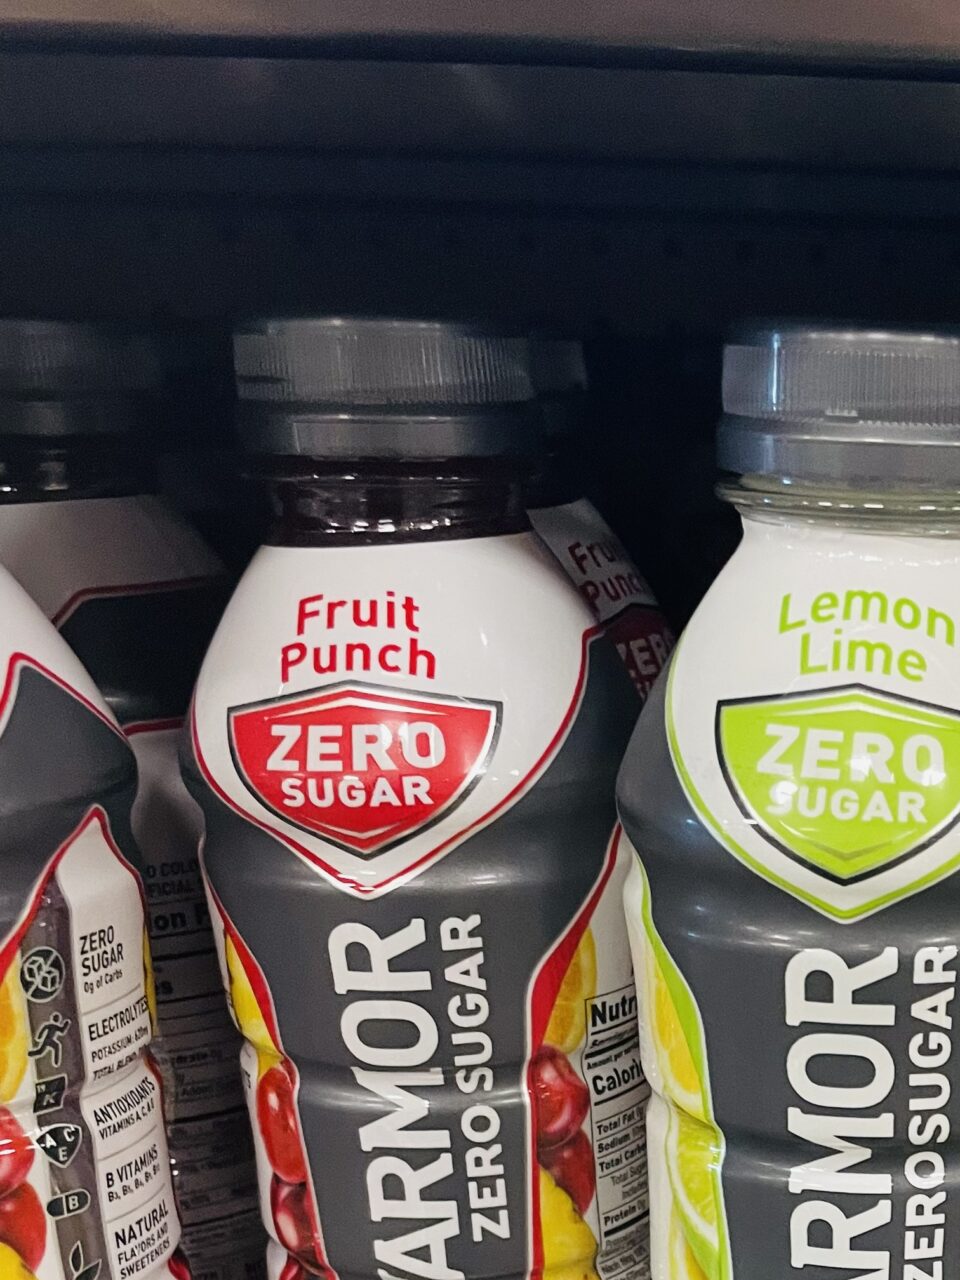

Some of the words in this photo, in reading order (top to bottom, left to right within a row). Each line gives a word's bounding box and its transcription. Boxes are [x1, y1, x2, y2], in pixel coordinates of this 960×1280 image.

[297, 590, 420, 636] Fruit
[778, 589, 956, 648] Lemon
[281, 637, 437, 684] Punch
[800, 627, 928, 683] Lime
[265, 721, 446, 773] ZERO
[756, 722, 947, 787] ZERO
[280, 775, 434, 808] SUGAR
[765, 781, 928, 825] SUGAR
[79, 925, 115, 956] ZERO
[82, 943, 124, 977] SUGAR
[439, 913, 494, 1095] SUGAR
[908, 945, 959, 1146] SUGAR
[93, 1077, 156, 1126] ANTIOXIDANTS
[99, 1113, 135, 1140] VITAMINS
[597, 1118, 621, 1136] Total
[106, 1171, 115, 1189] B
[460, 1104, 511, 1243] ZERO
[114, 1200, 169, 1249] NATURAL
[117, 1233, 156, 1266] FLAVORS
[120, 1239, 171, 1280] SWEETENERS
